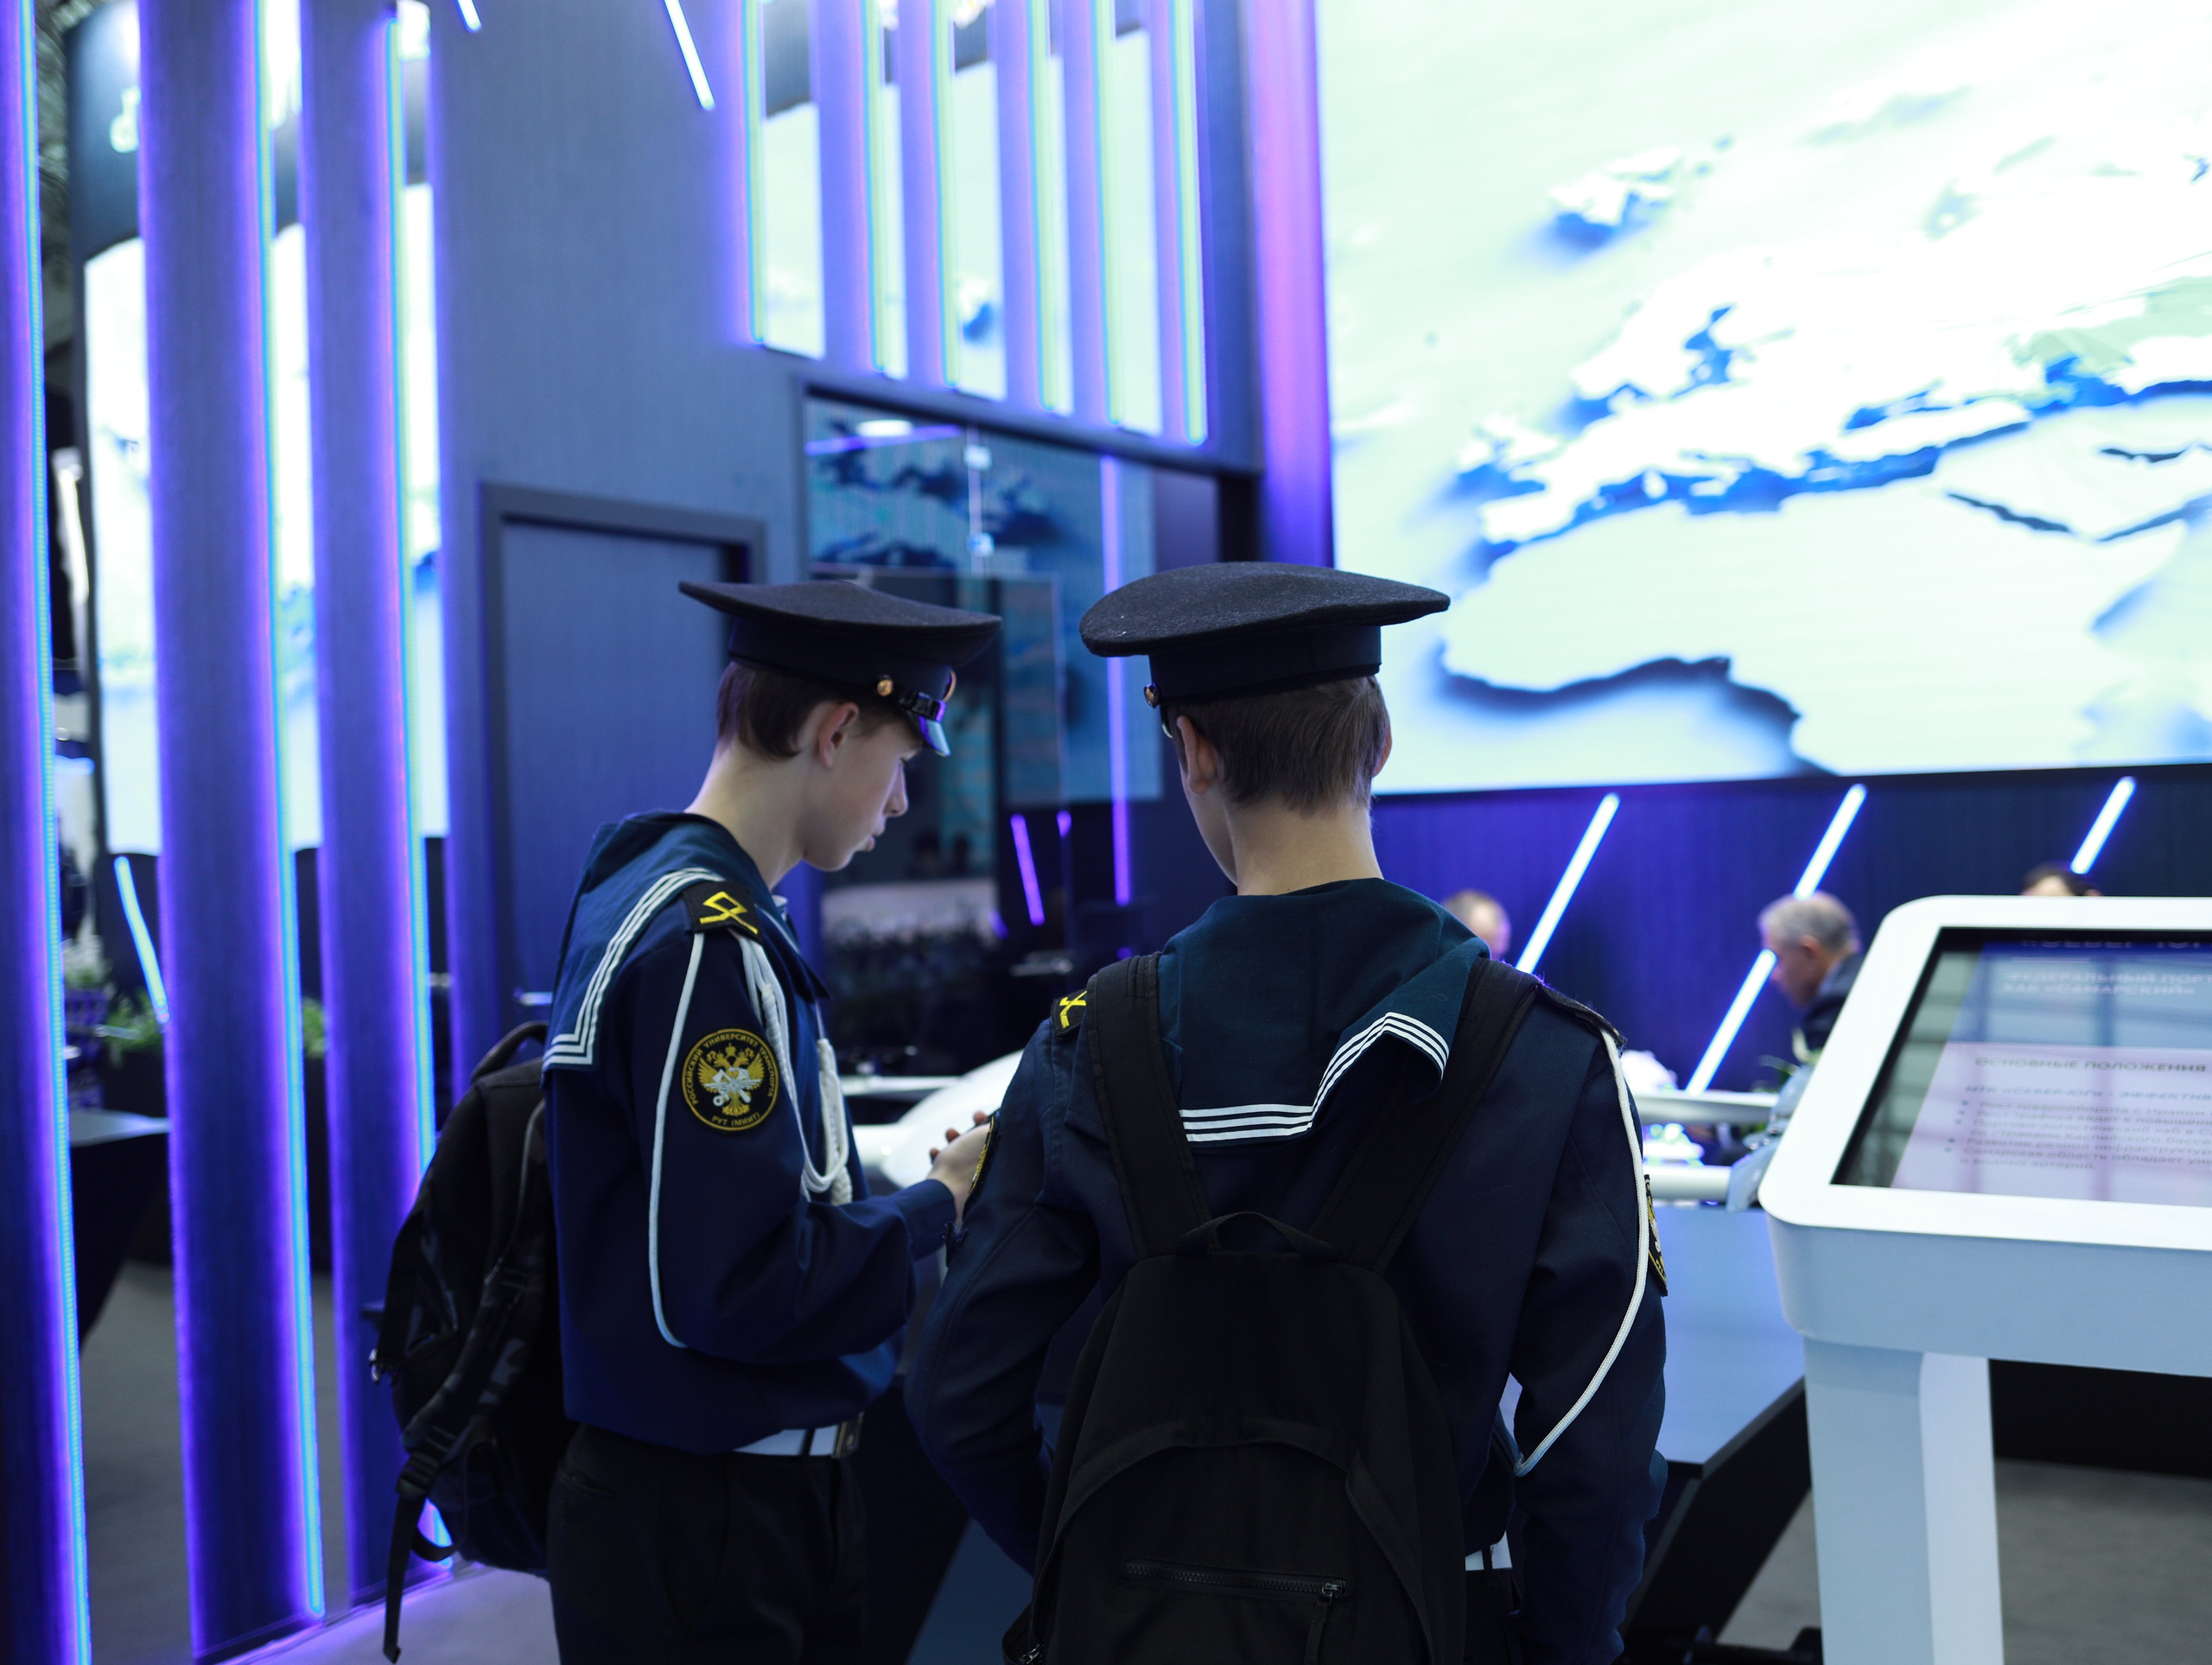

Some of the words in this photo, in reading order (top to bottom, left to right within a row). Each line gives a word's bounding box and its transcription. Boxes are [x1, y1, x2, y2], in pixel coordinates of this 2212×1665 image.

[686, 1048, 702, 1105] РОССИЙСКИЙ
[703, 1033, 759, 1048] УНИВЕРСИТЕТ
[760, 1047, 775, 1097] ТРАНСПОРТА
[1974, 1057, 2078, 1070] ОСНОВНЫЕ
[2083, 1060, 2207, 1073] ПОЛОЖЕНИЯ
[712, 1115, 728, 1126] РУТ
[731, 1112, 761, 1128] (МИИТ)
